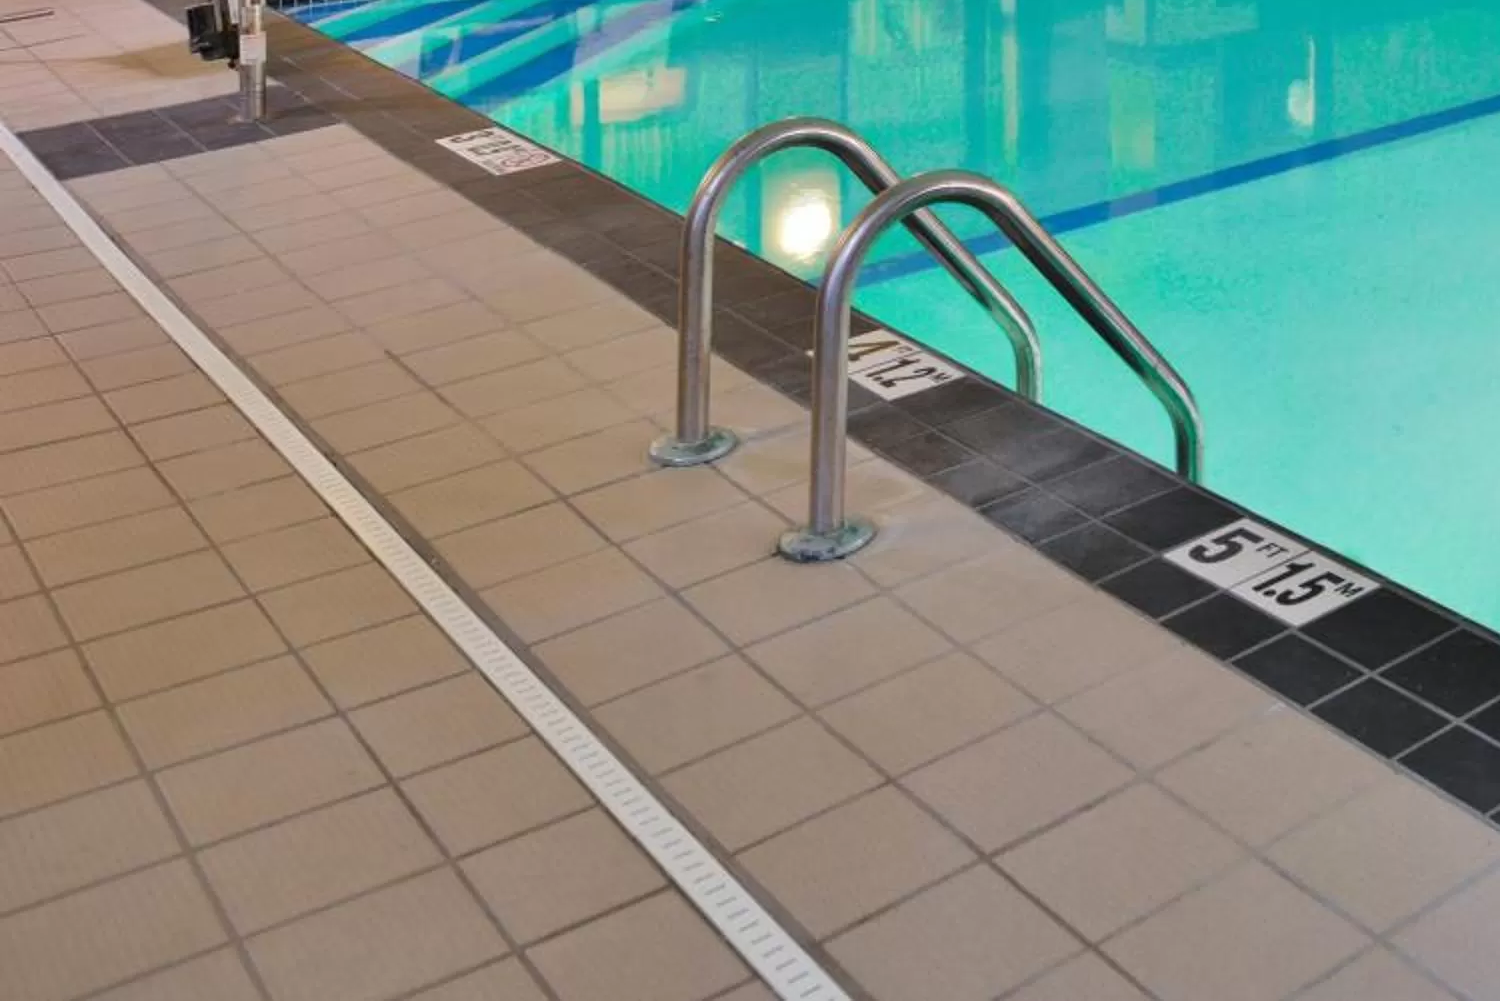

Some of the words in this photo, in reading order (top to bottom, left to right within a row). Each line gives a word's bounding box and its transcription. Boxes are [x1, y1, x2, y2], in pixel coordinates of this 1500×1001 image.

[865, 359, 937, 388] 1.2
[1188, 527, 1265, 564] 5
[1254, 542, 1292, 558] FT
[1252, 562, 1346, 607] 1.5
[1333, 582, 1364, 598] M
